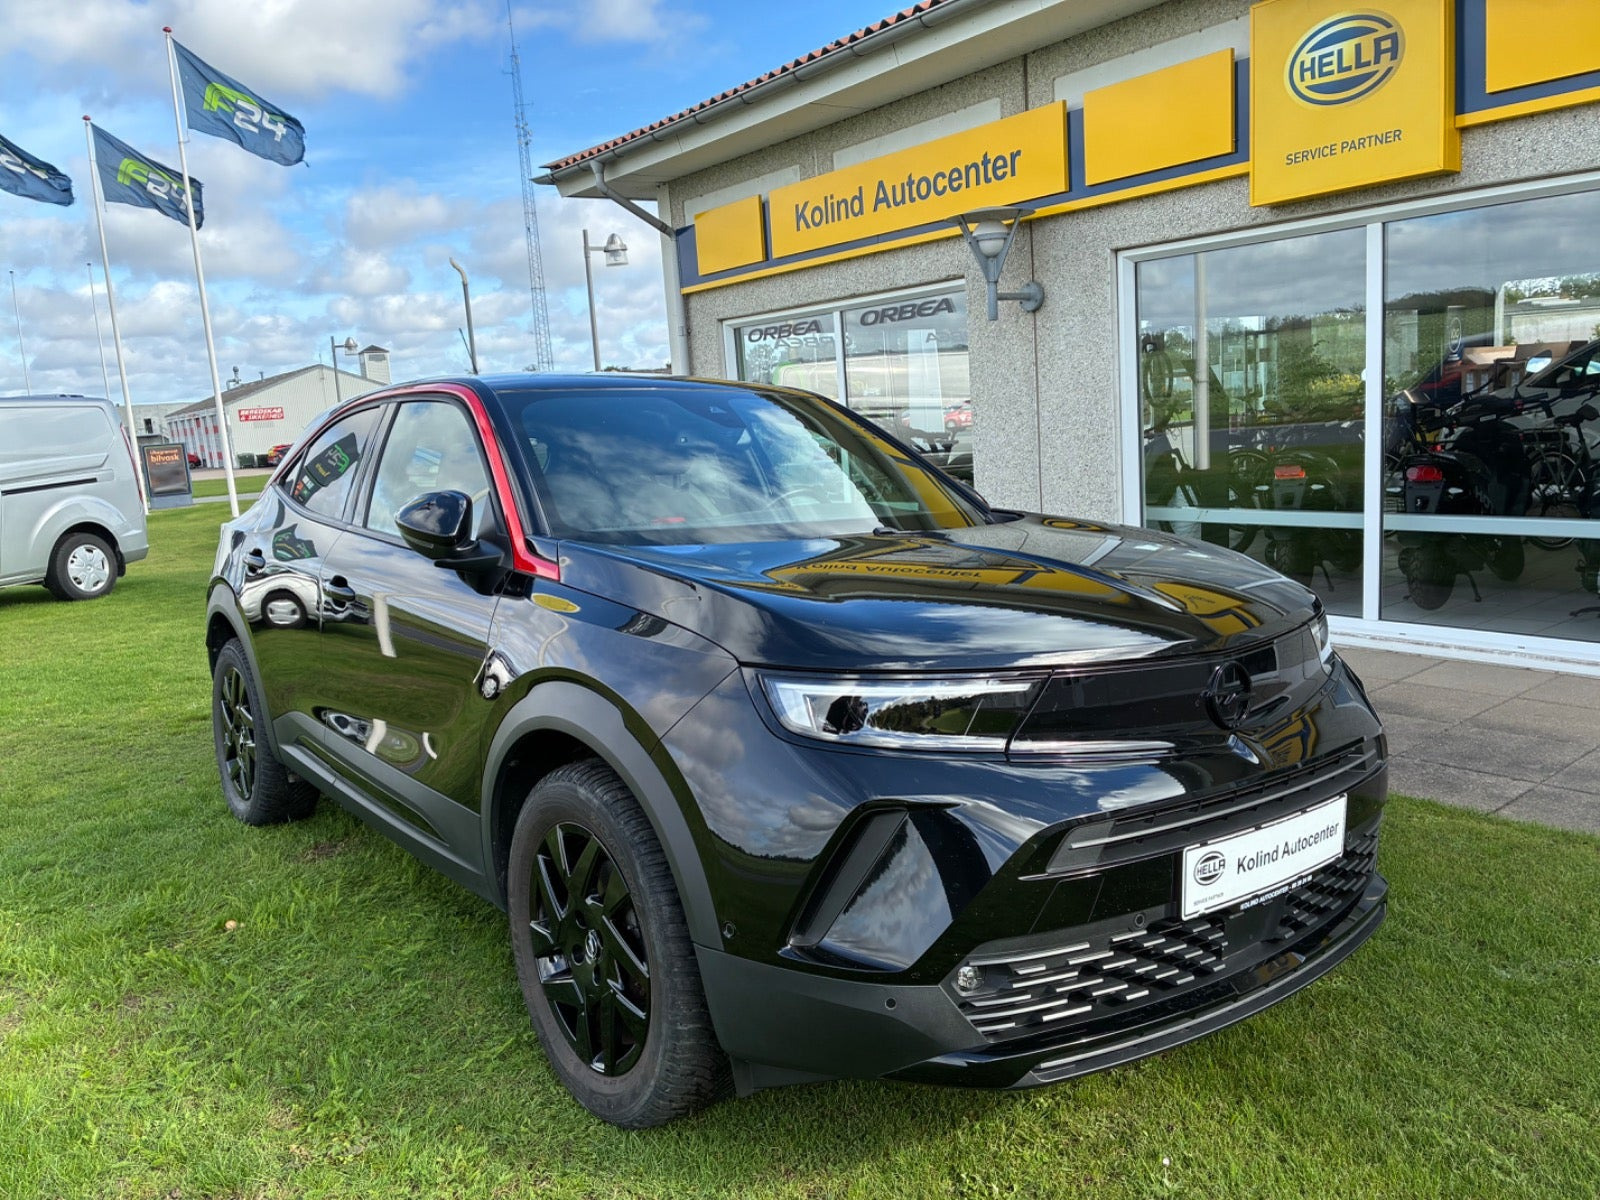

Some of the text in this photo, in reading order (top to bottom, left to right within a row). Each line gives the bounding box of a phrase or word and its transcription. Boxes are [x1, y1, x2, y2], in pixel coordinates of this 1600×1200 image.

[1300, 31, 1399, 83] HELLA
[203, 82, 287, 141] F24
[1285, 129, 1402, 166] SERVICE PARTNER
[795, 149, 1022, 232] Kolind Autocenter
[748, 319, 822, 343] ORBEA
[860, 298, 956, 327] ORBEA
[151, 453, 179, 462] bilvask
[1196, 857, 1226, 877] HELLA
[1236, 823, 1340, 875] Kolind Autocenter
